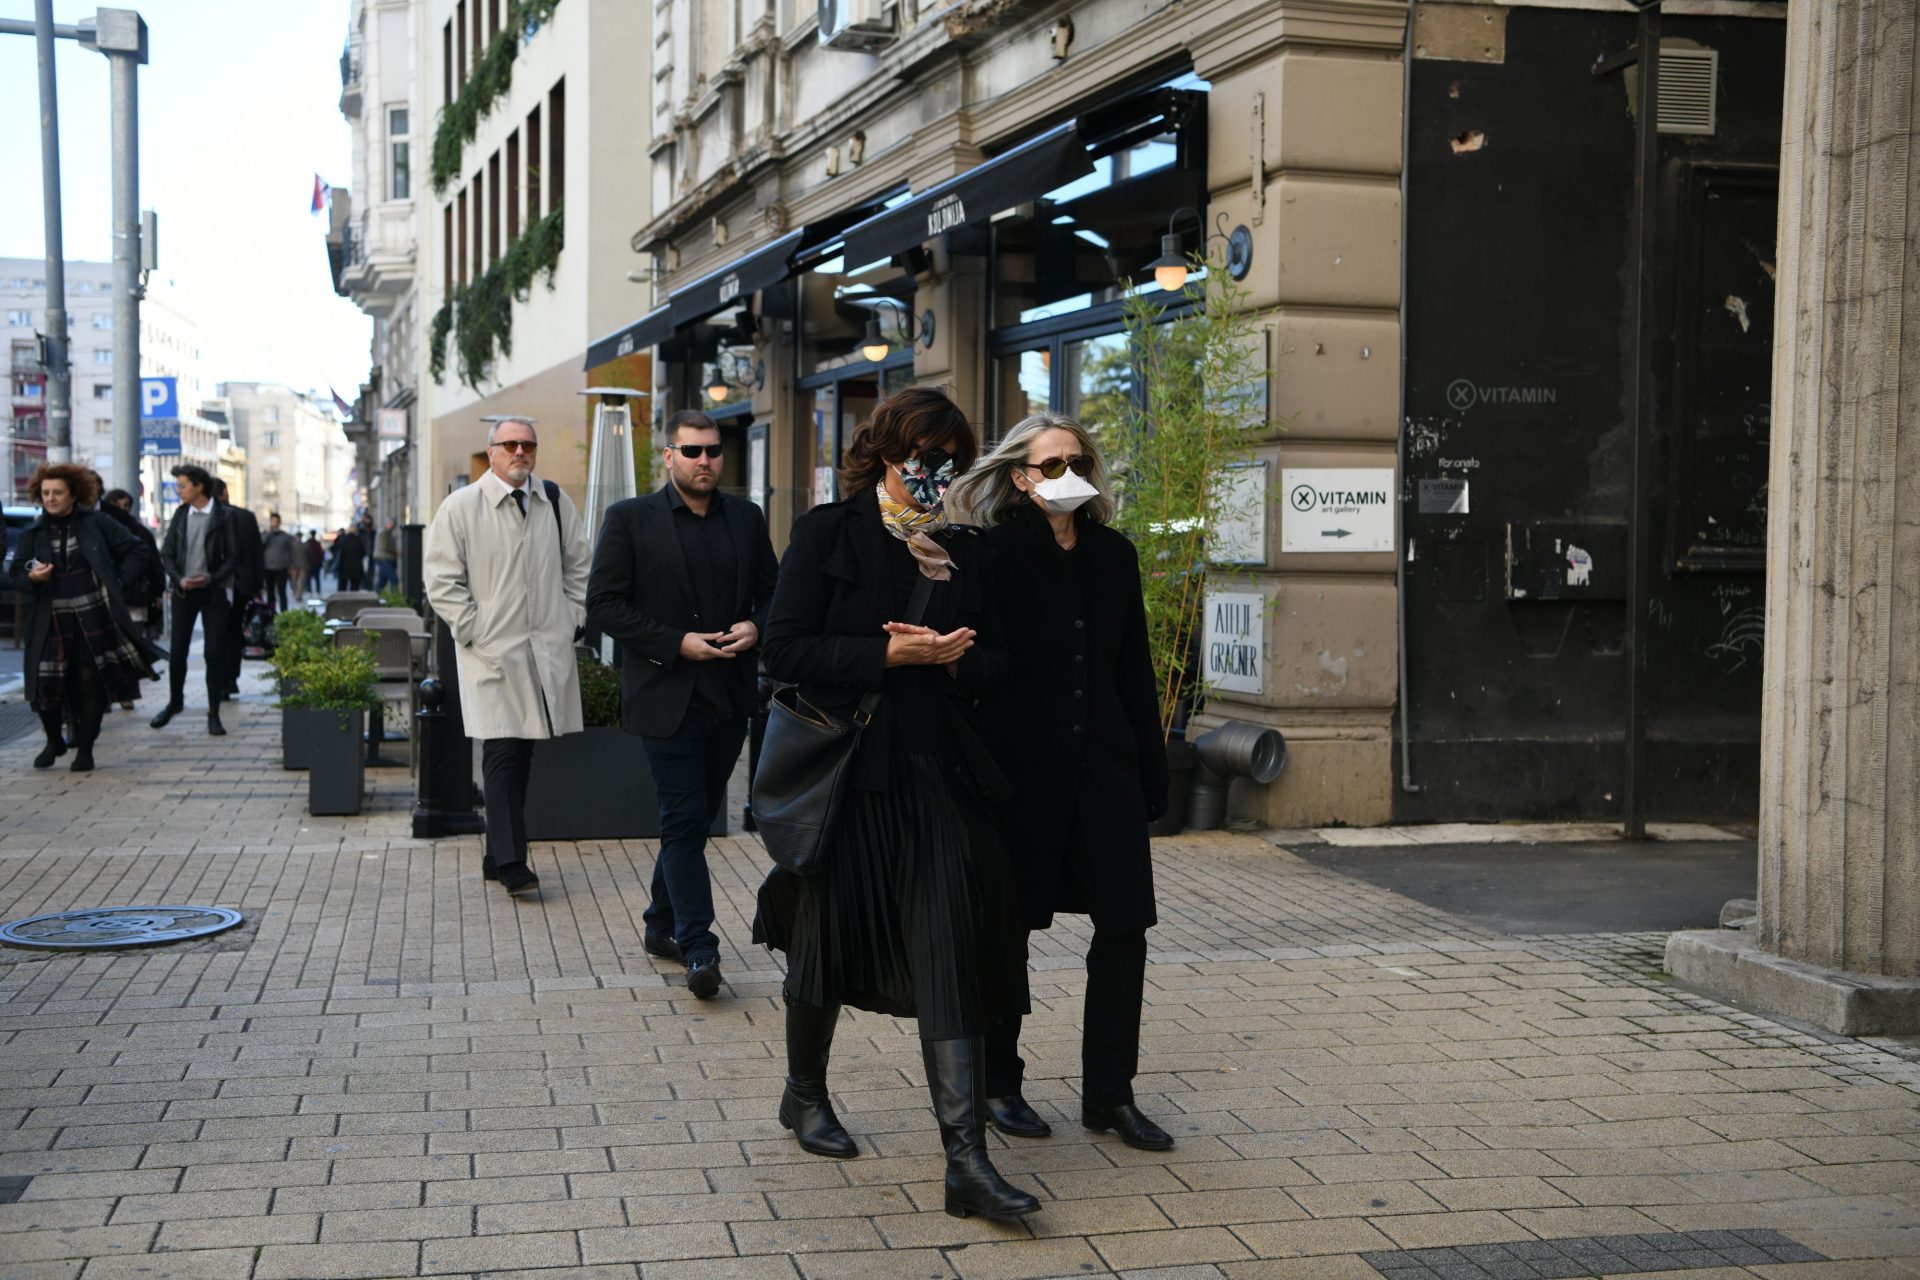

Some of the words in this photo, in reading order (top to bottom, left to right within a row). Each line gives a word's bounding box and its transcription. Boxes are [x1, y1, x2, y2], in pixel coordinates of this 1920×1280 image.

[142, 380, 168, 415] P
[1478, 387, 1556, 403] VITAMIN
[1318, 491, 1386, 505] VITAMIN
[1334, 505, 1361, 514] gallery
[1210, 639, 1258, 678] GRAČNER
